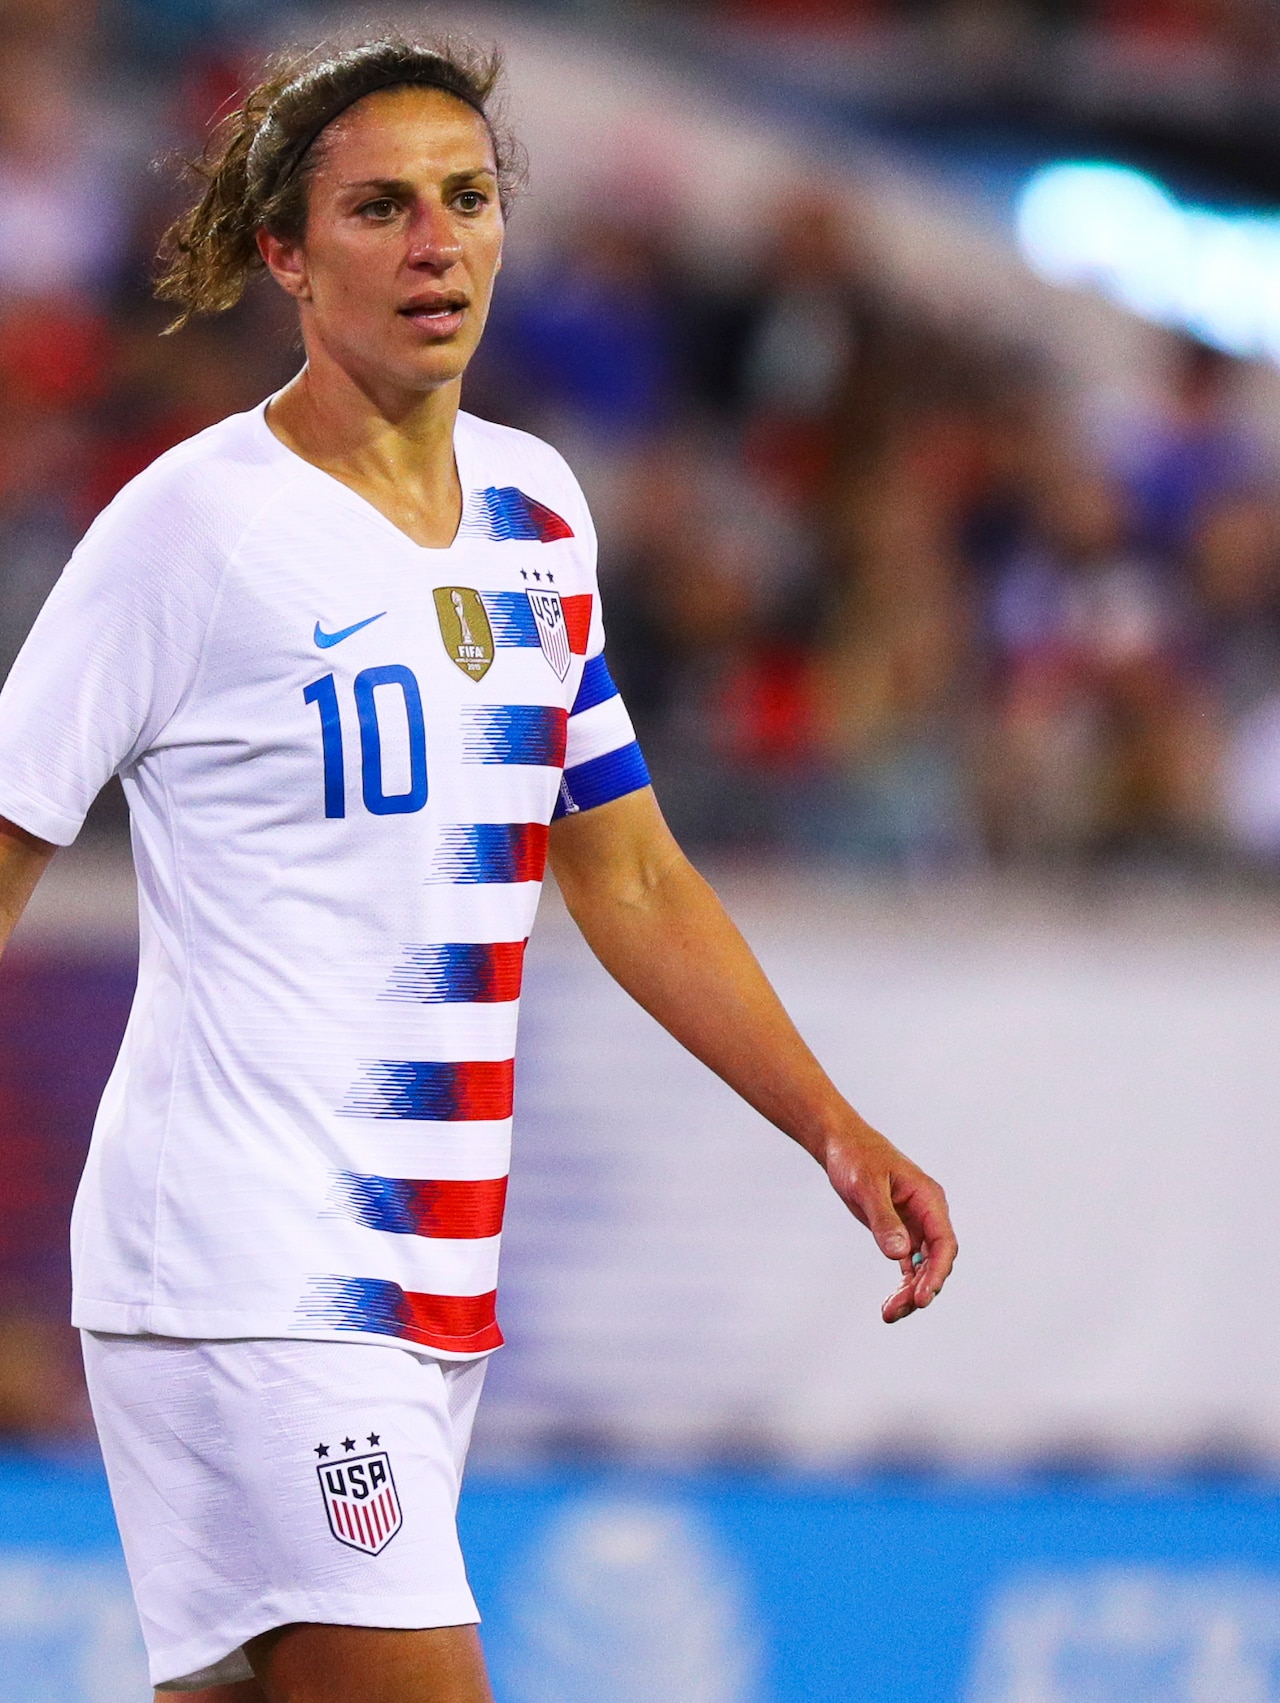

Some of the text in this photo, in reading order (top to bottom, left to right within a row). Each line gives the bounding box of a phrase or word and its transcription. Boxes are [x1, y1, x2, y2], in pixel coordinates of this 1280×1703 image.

[531, 595, 561, 628] USA
[458, 645, 484, 658] FIFA
[303, 664, 429, 819] 10
[325, 1460, 387, 1500] USA
